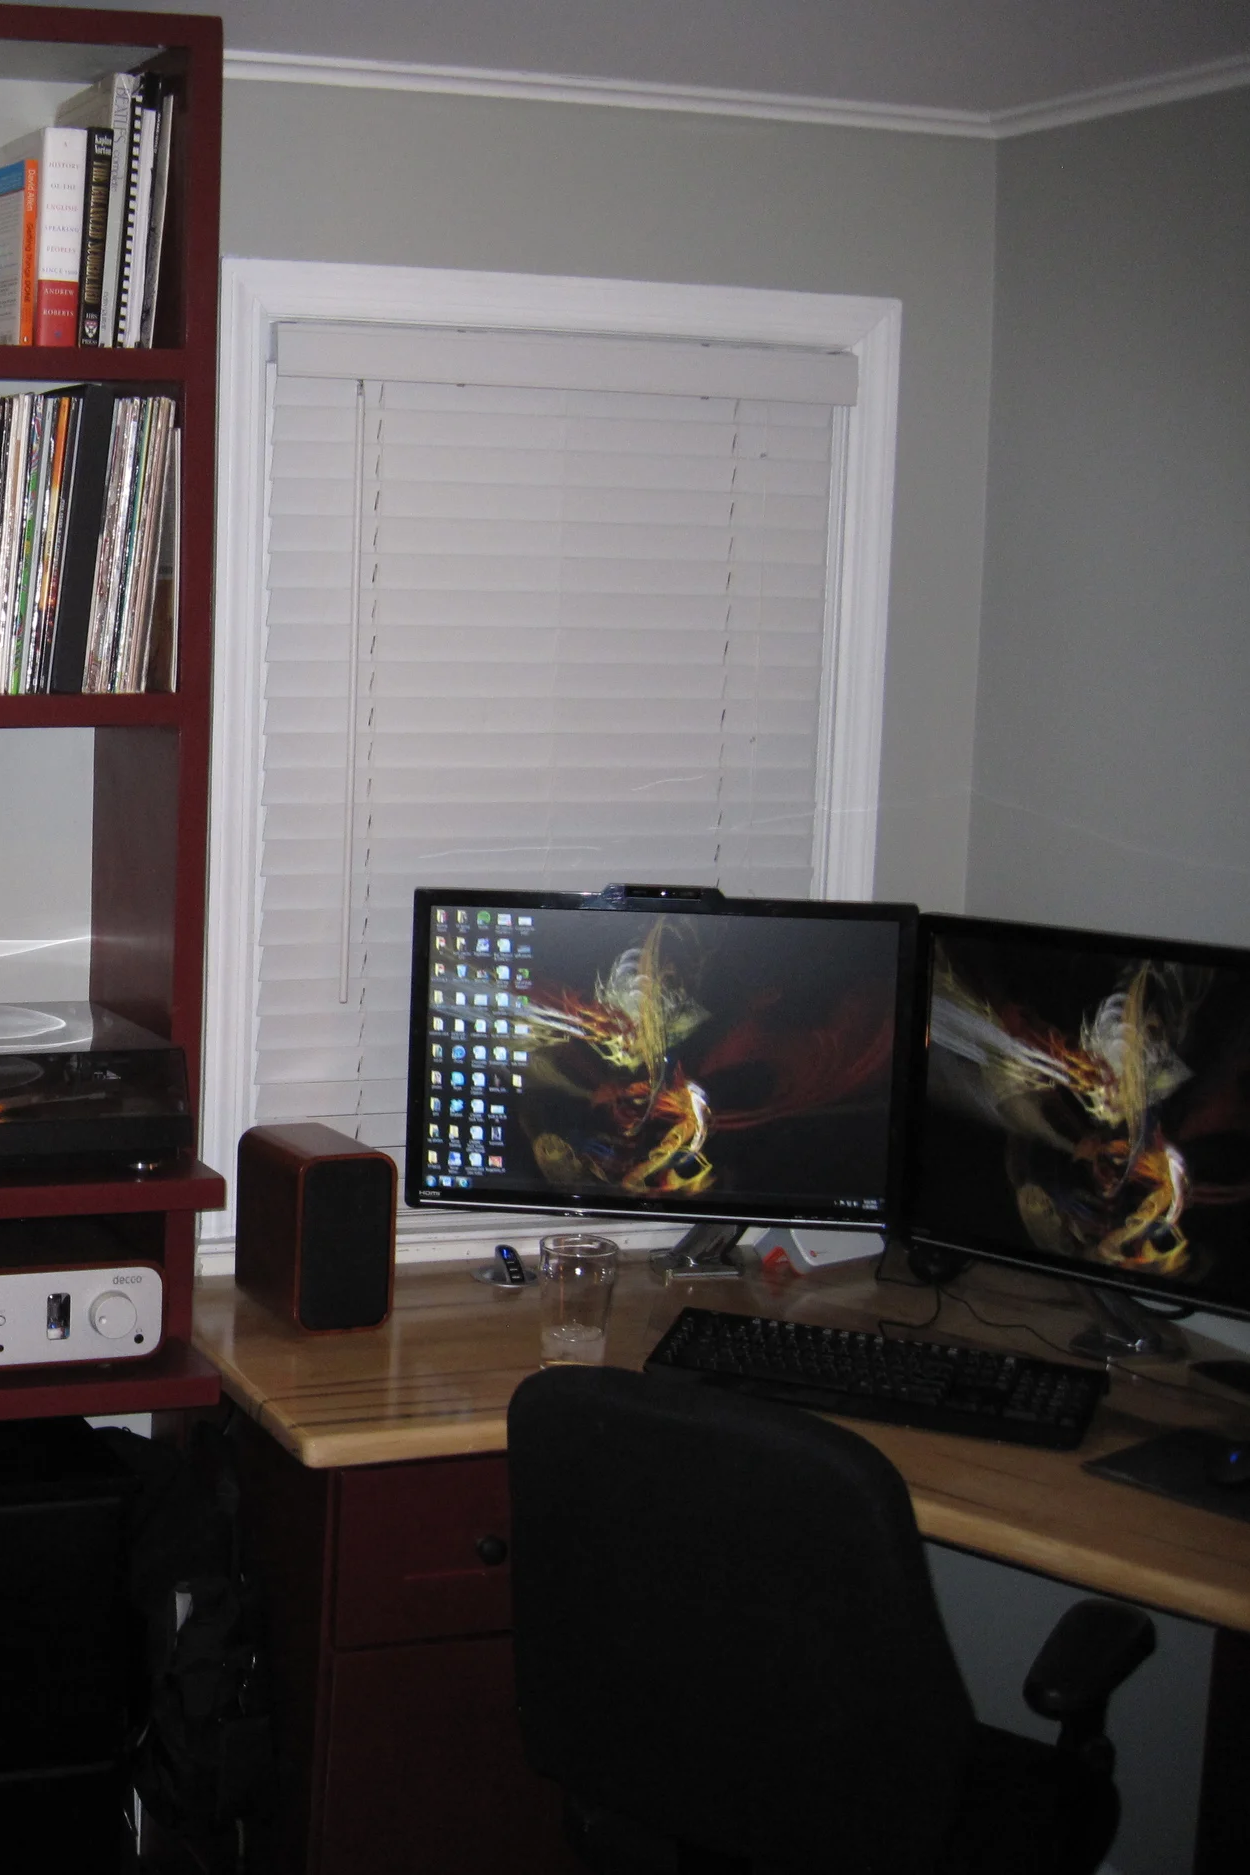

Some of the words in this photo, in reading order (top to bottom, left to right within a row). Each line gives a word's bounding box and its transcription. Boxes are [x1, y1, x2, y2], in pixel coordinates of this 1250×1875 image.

[48, 162, 80, 170] HISTORY
[92, 161, 111, 182] THE
[27, 169, 36, 192] David
[26, 193, 35, 211] Allen
[88, 185, 110, 239] BALANCED
[23, 222, 34, 252] Getting
[84, 241, 104, 304] SCORECARD
[24, 279, 32, 303] DONE
[43, 287, 75, 296] ANDREW
[112, 1273, 143, 1285] decco
